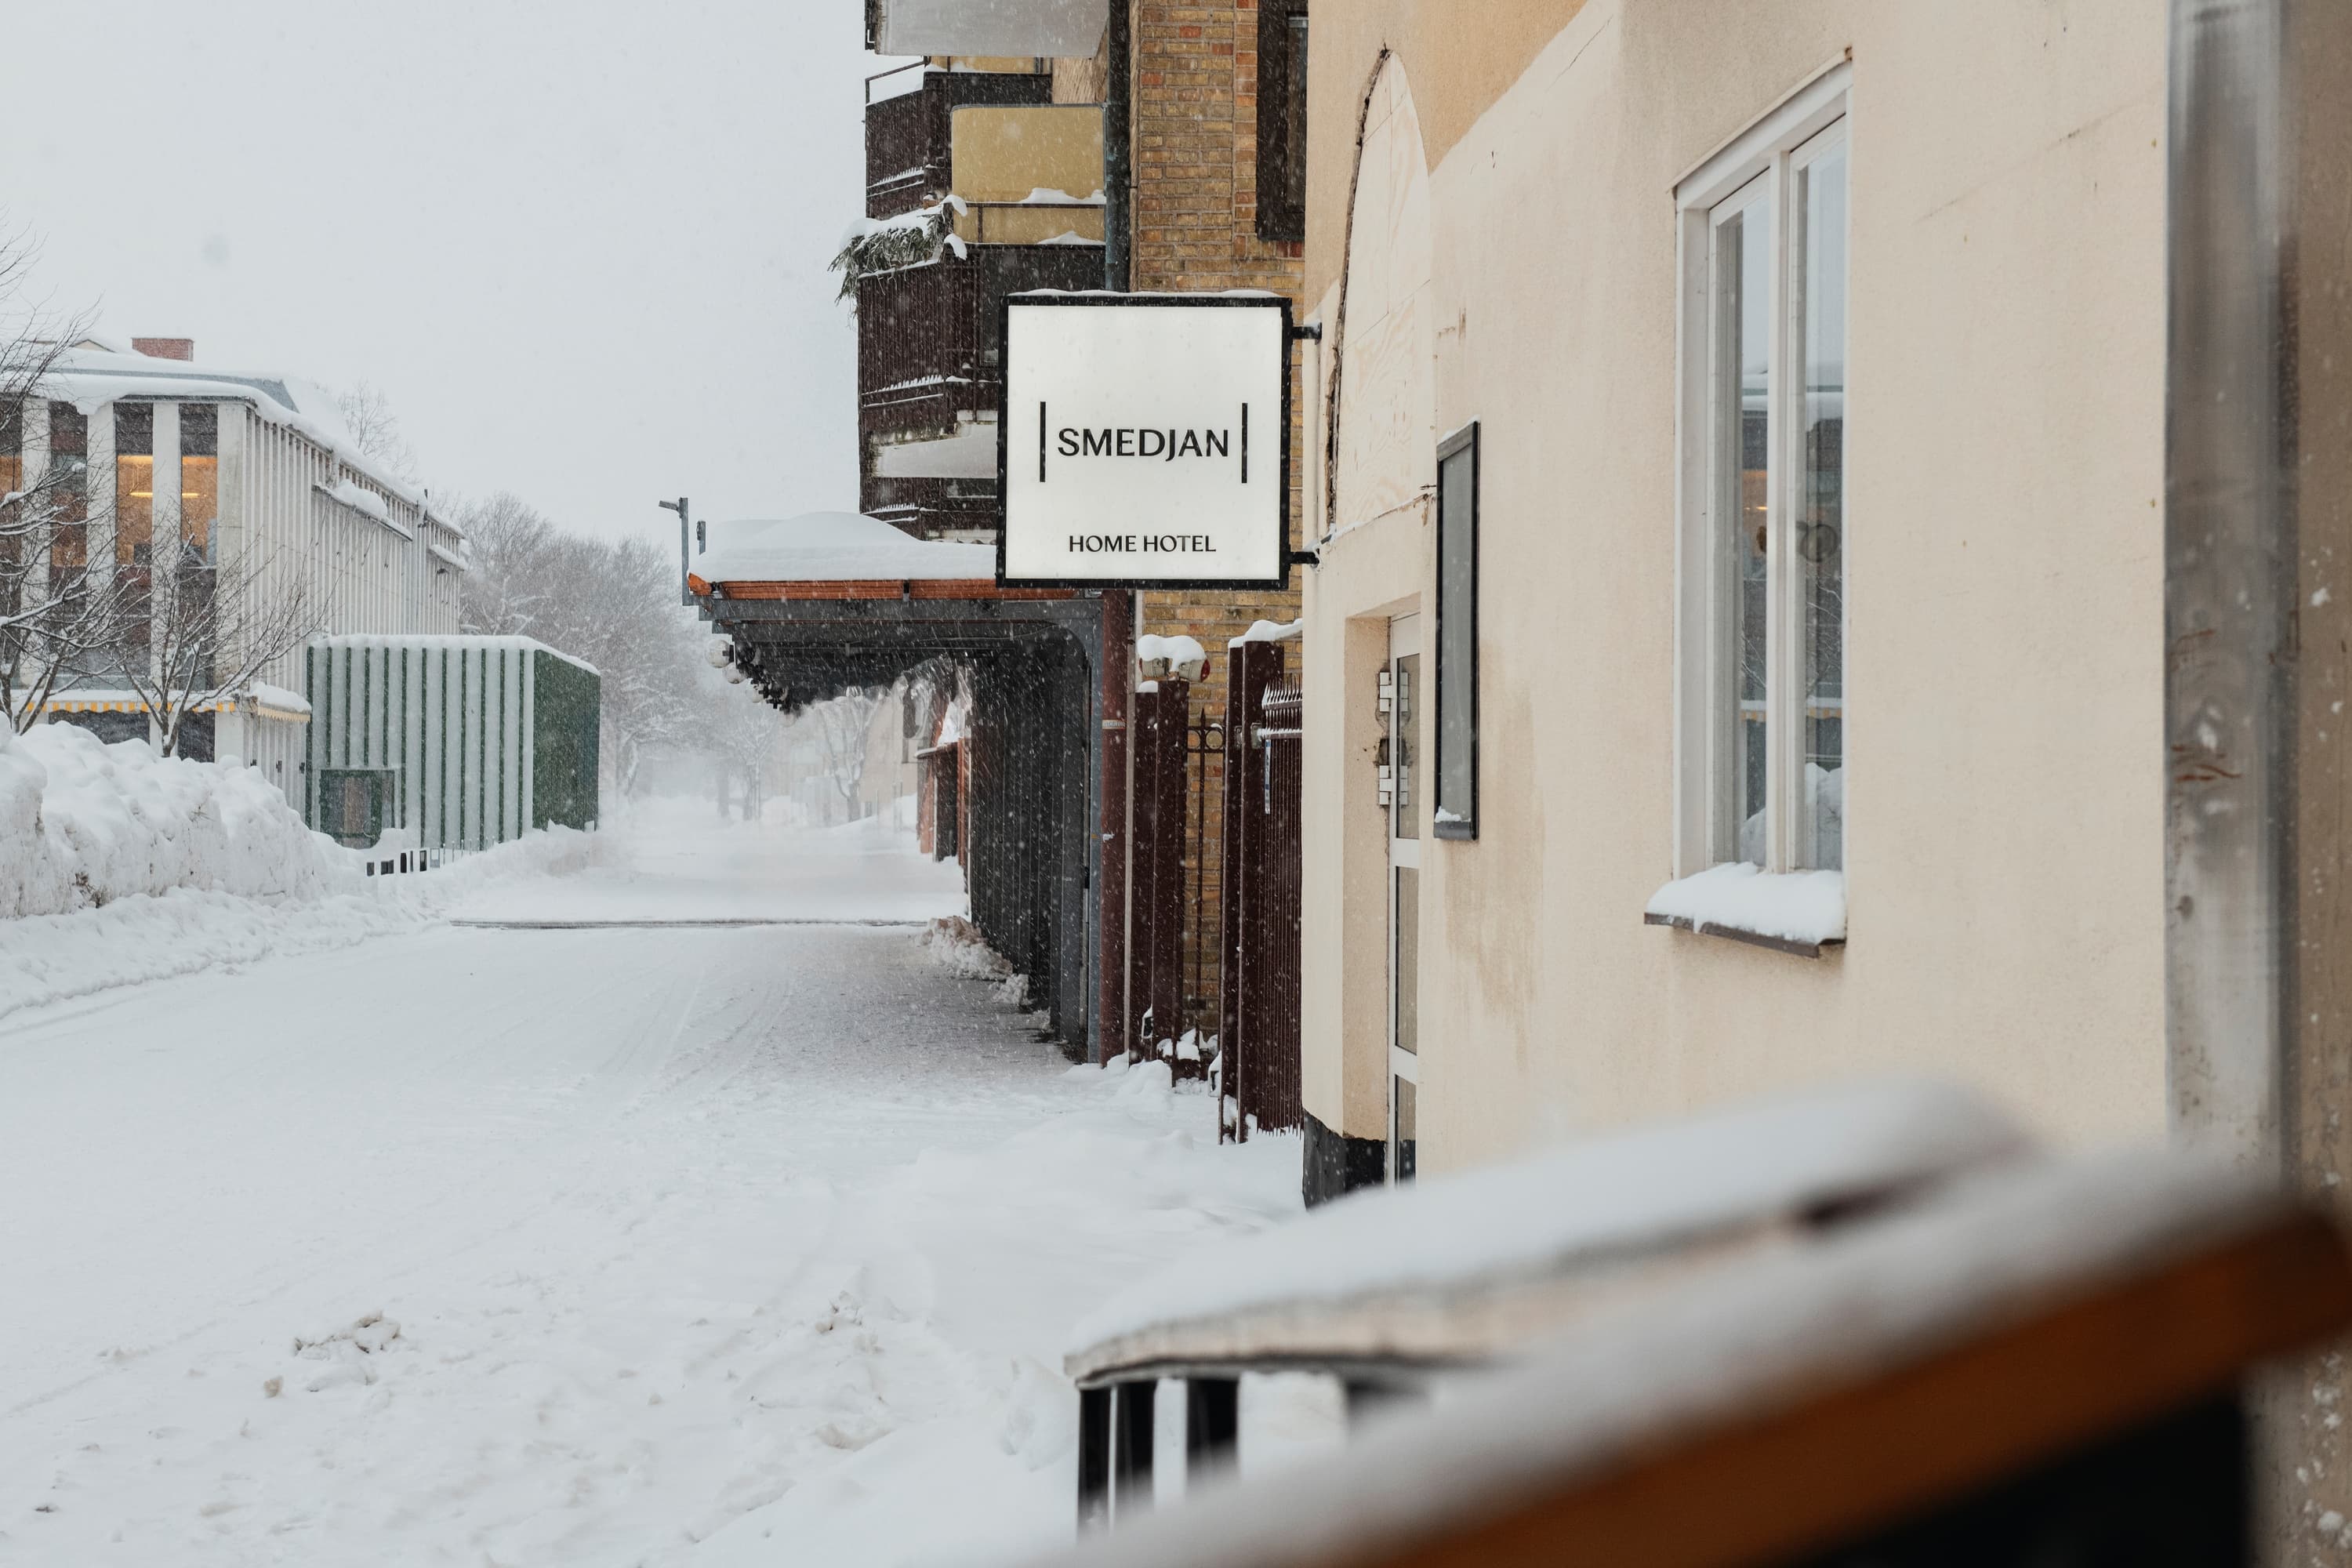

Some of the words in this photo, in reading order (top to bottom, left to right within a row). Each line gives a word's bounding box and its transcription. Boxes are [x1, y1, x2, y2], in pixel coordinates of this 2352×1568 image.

[1058, 427, 1229, 462] SMEDJAN
[1069, 535, 1137, 553] HOME
[1143, 535, 1217, 553] HOTEL
